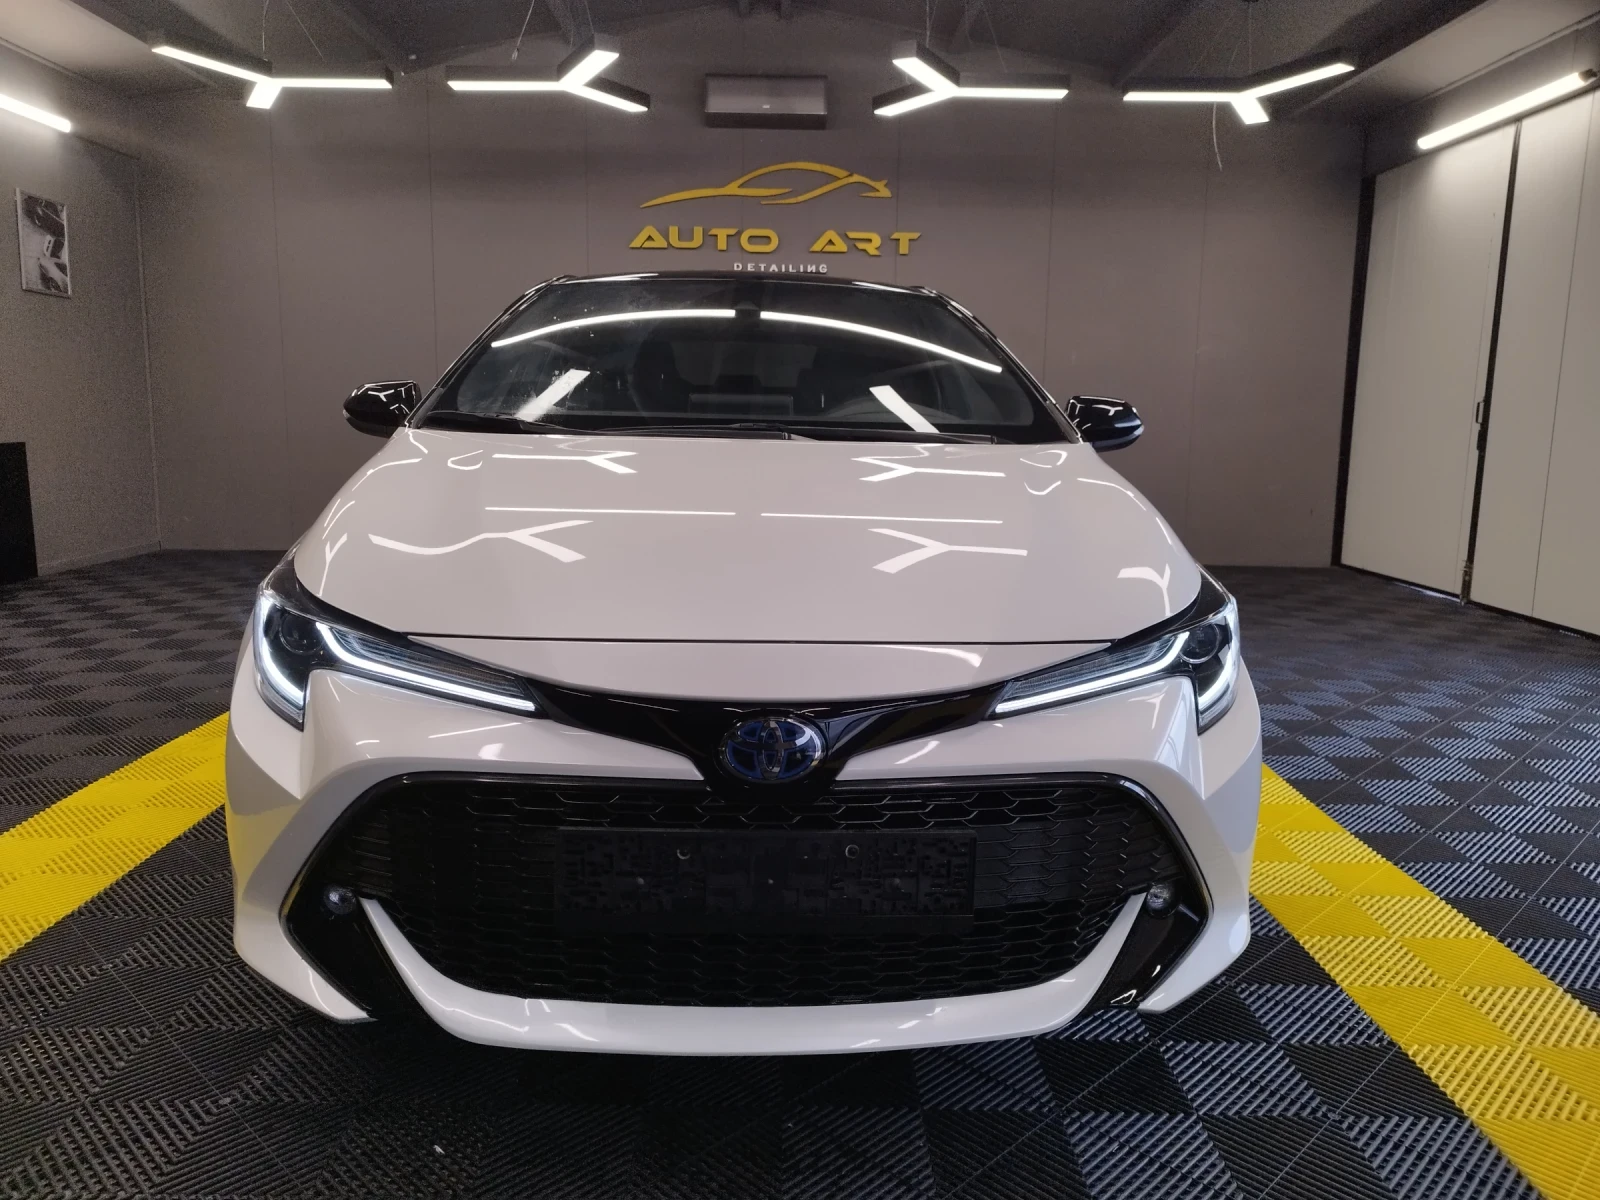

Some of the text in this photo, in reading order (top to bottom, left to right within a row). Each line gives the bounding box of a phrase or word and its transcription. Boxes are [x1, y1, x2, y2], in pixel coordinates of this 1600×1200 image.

[629, 225, 922, 256] AUTO ART
[733, 262, 828, 273] DETAILING
